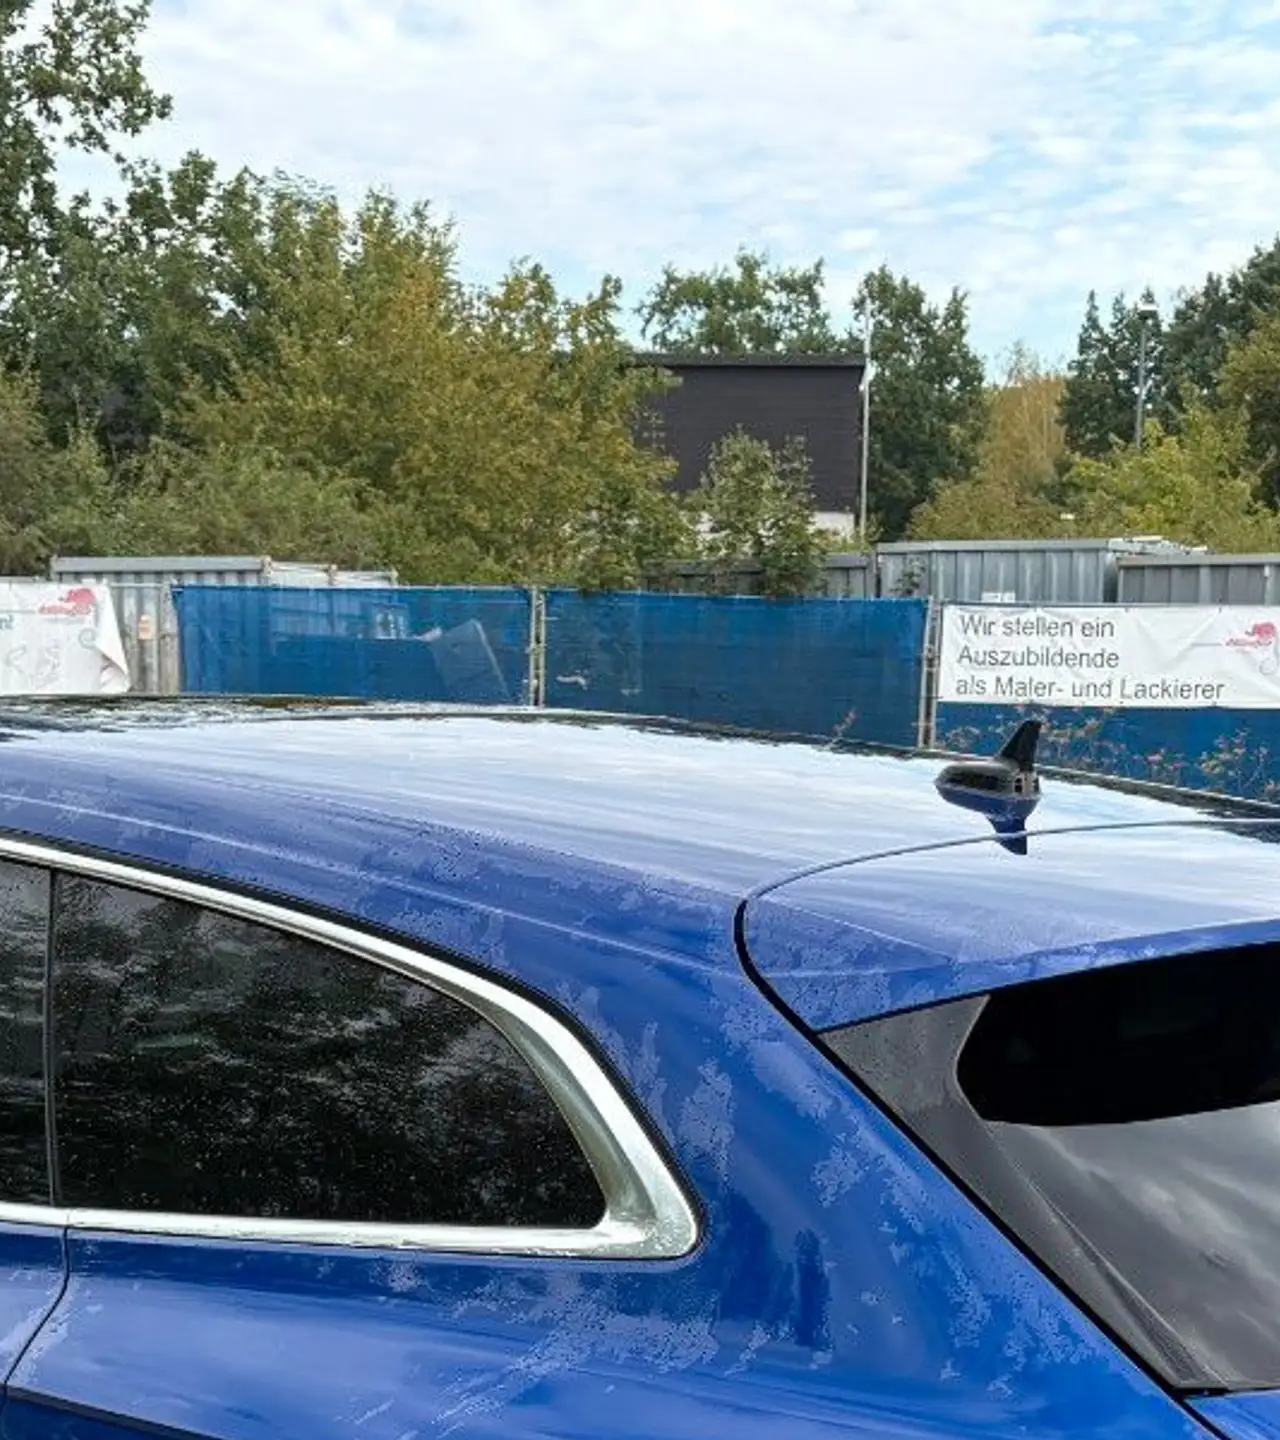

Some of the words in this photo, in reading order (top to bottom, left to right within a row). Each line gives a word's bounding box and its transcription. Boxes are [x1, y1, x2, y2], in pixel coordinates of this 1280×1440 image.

[960, 615, 996, 637] Wir
[1002, 615, 1073, 638] stellen
[1081, 616, 1114, 638] ein
[957, 645, 1119, 669] Auszubildende
[956, 676, 986, 696] als
[995, 677, 1063, 699] Maler-
[1072, 677, 1111, 699] und
[1120, 677, 1224, 700] Lackierer
